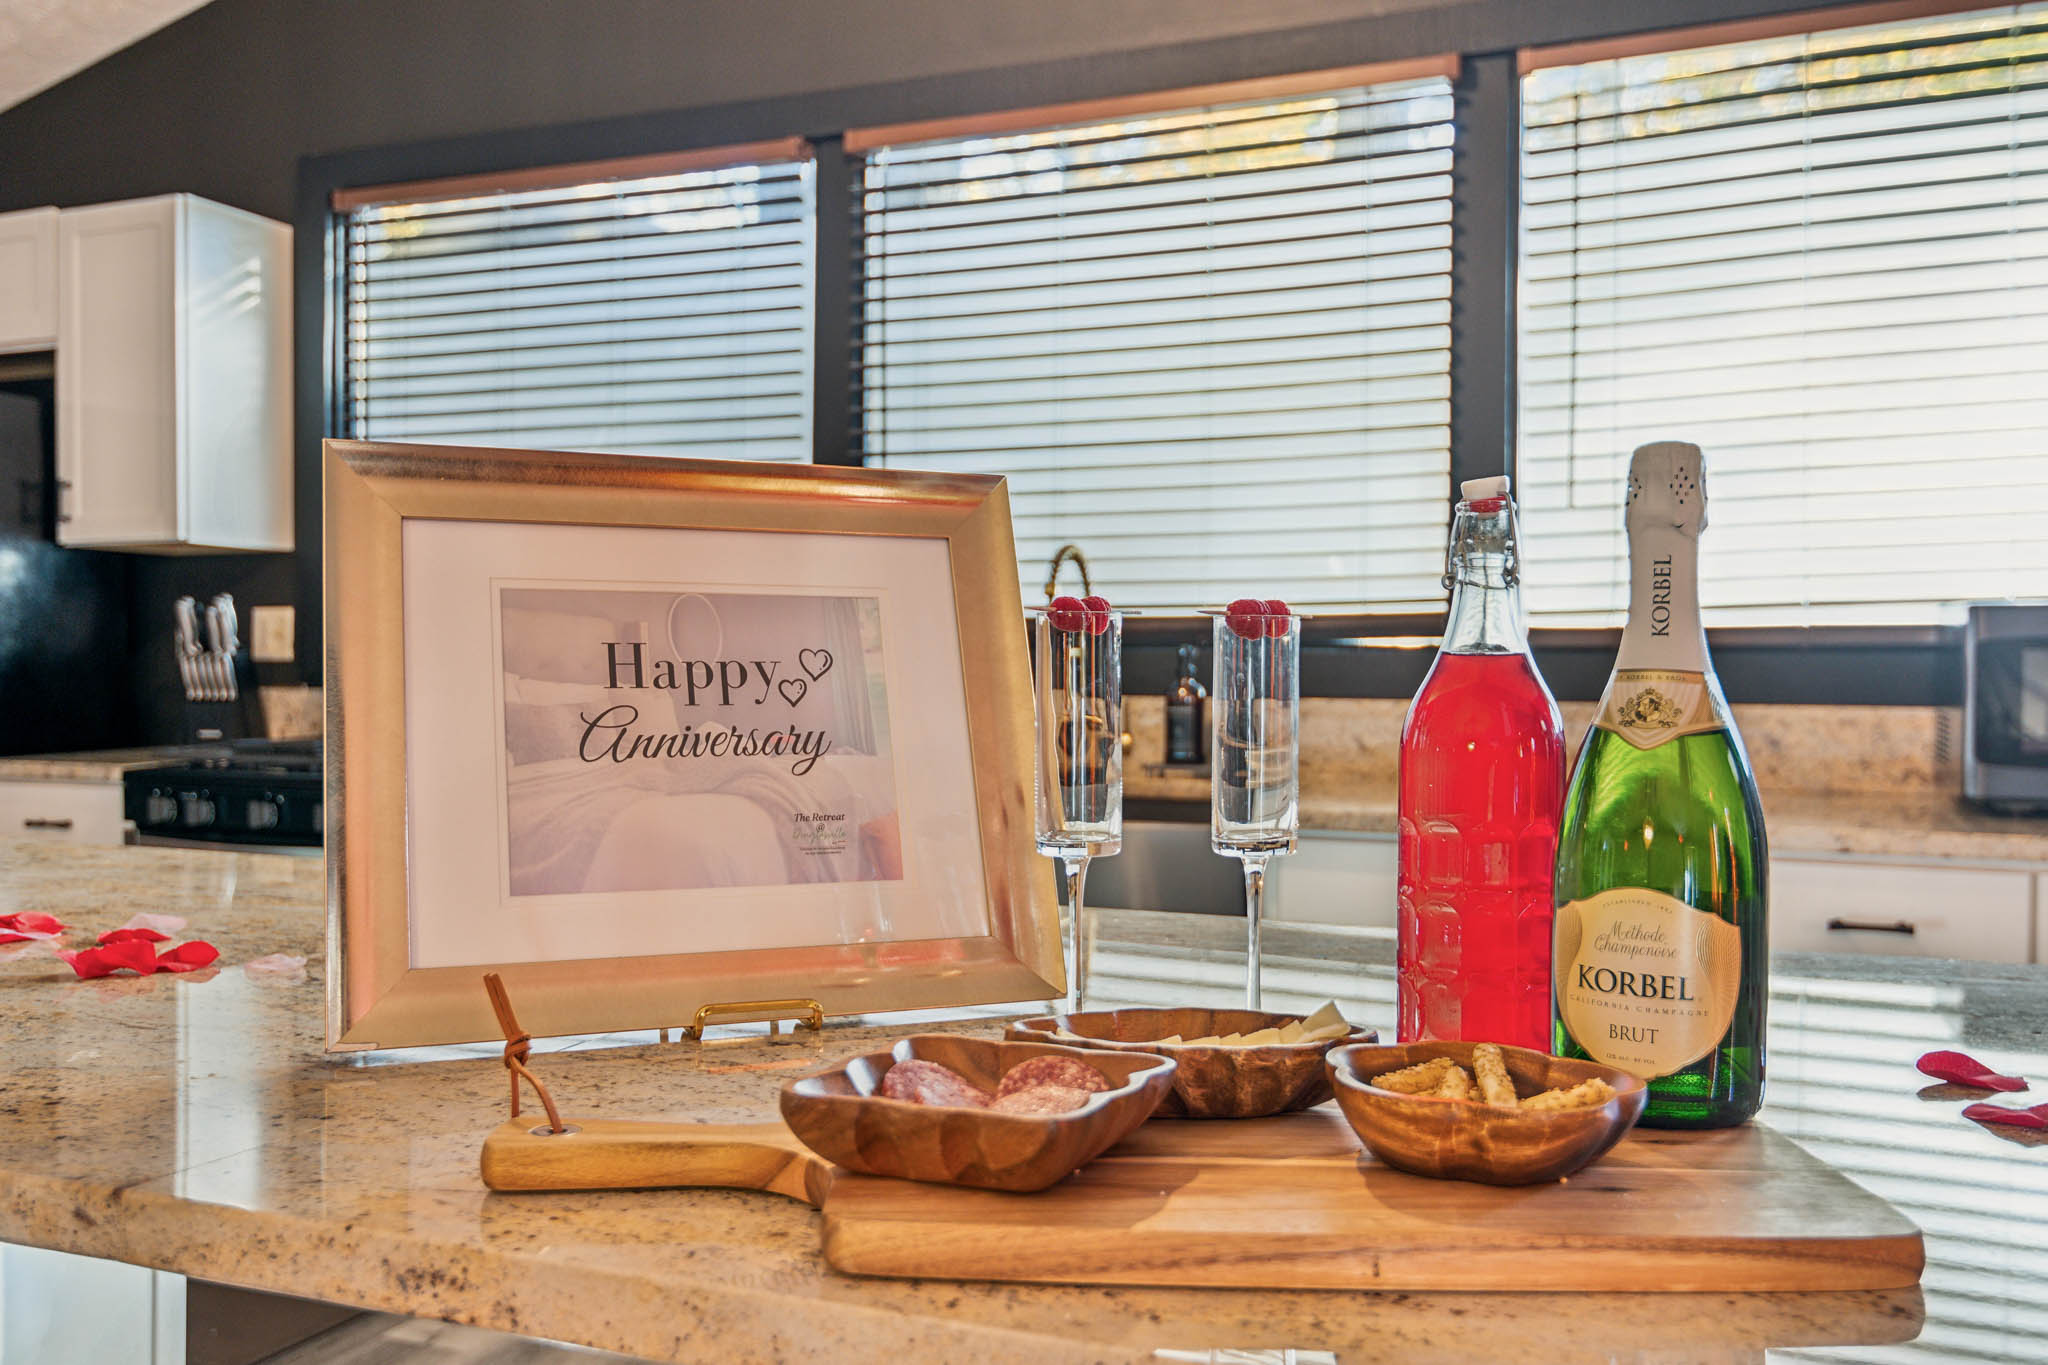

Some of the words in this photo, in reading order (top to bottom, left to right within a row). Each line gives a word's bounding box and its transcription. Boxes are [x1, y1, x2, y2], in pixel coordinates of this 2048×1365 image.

[1651, 554, 1672, 637] KORBEL
[601, 642, 781, 706] Happy
[579, 704, 832, 776] Anniversary
[794, 812, 811, 822] The
[812, 812, 845, 822] Retreat
[1578, 964, 1694, 1001] KORBEL
[1569, 993, 1630, 1011] CALIFORNIA
[1635, 1006, 1710, 1017] CHAMPAGNE
[1608, 1023, 1660, 1045] BRUT
